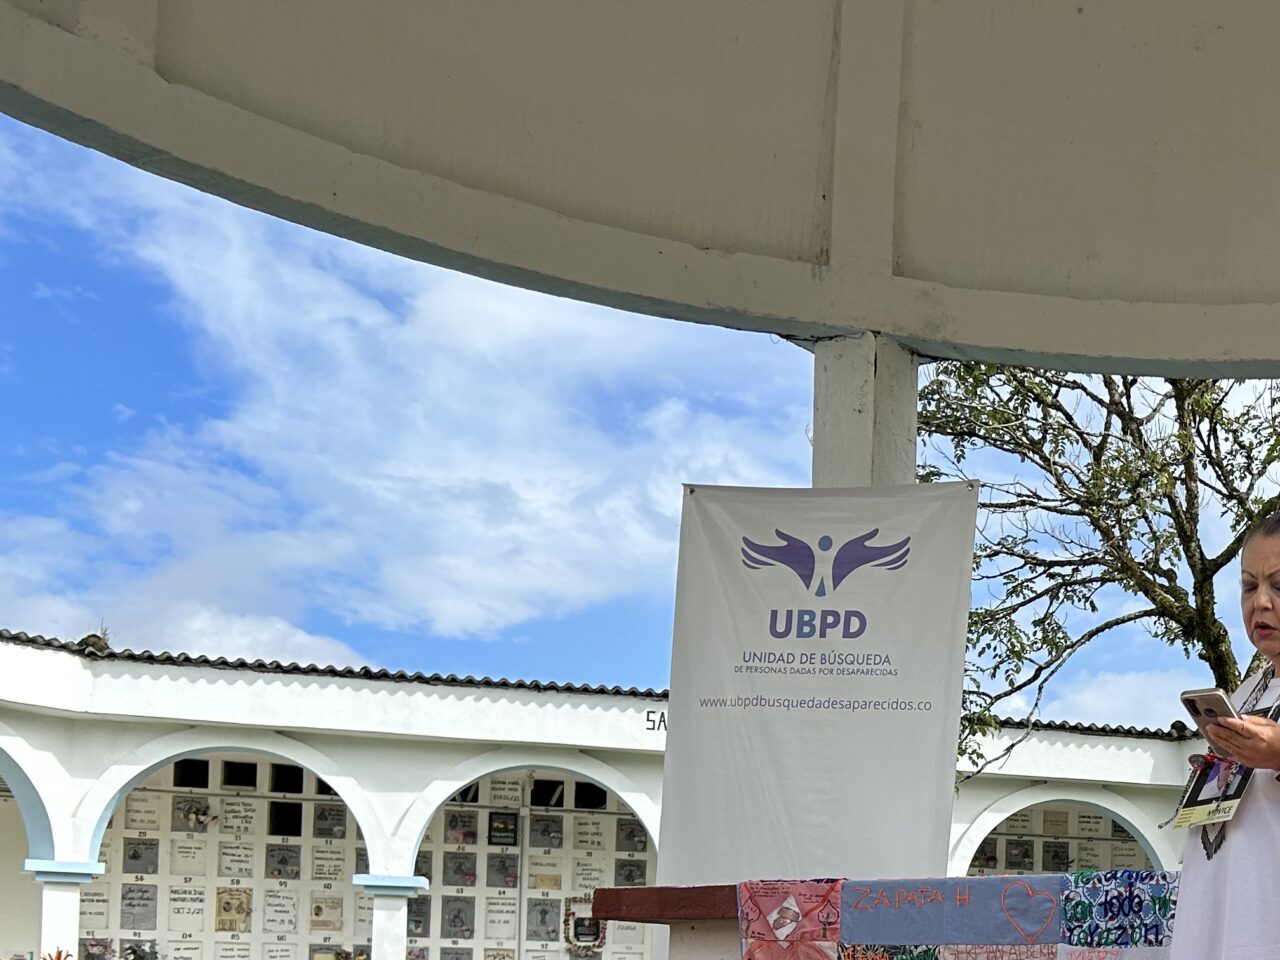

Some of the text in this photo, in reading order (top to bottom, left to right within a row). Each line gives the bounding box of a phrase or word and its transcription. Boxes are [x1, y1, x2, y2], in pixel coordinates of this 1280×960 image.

[769, 609, 867, 640] UBPD
[742, 650, 892, 667] UNIDAD DE BÚSQUEDA
[734, 666, 898, 677] DE PERSONAS DADAS POR DESAPARECIDAS
[699, 694, 932, 713] www.ubpdbusquedadesaparecidos.co
[646, 710, 668, 731] SA
[851, 886, 945, 911] ZAPATA
[956, 882, 971, 908] H
[1098, 881, 1144, 918] todo
